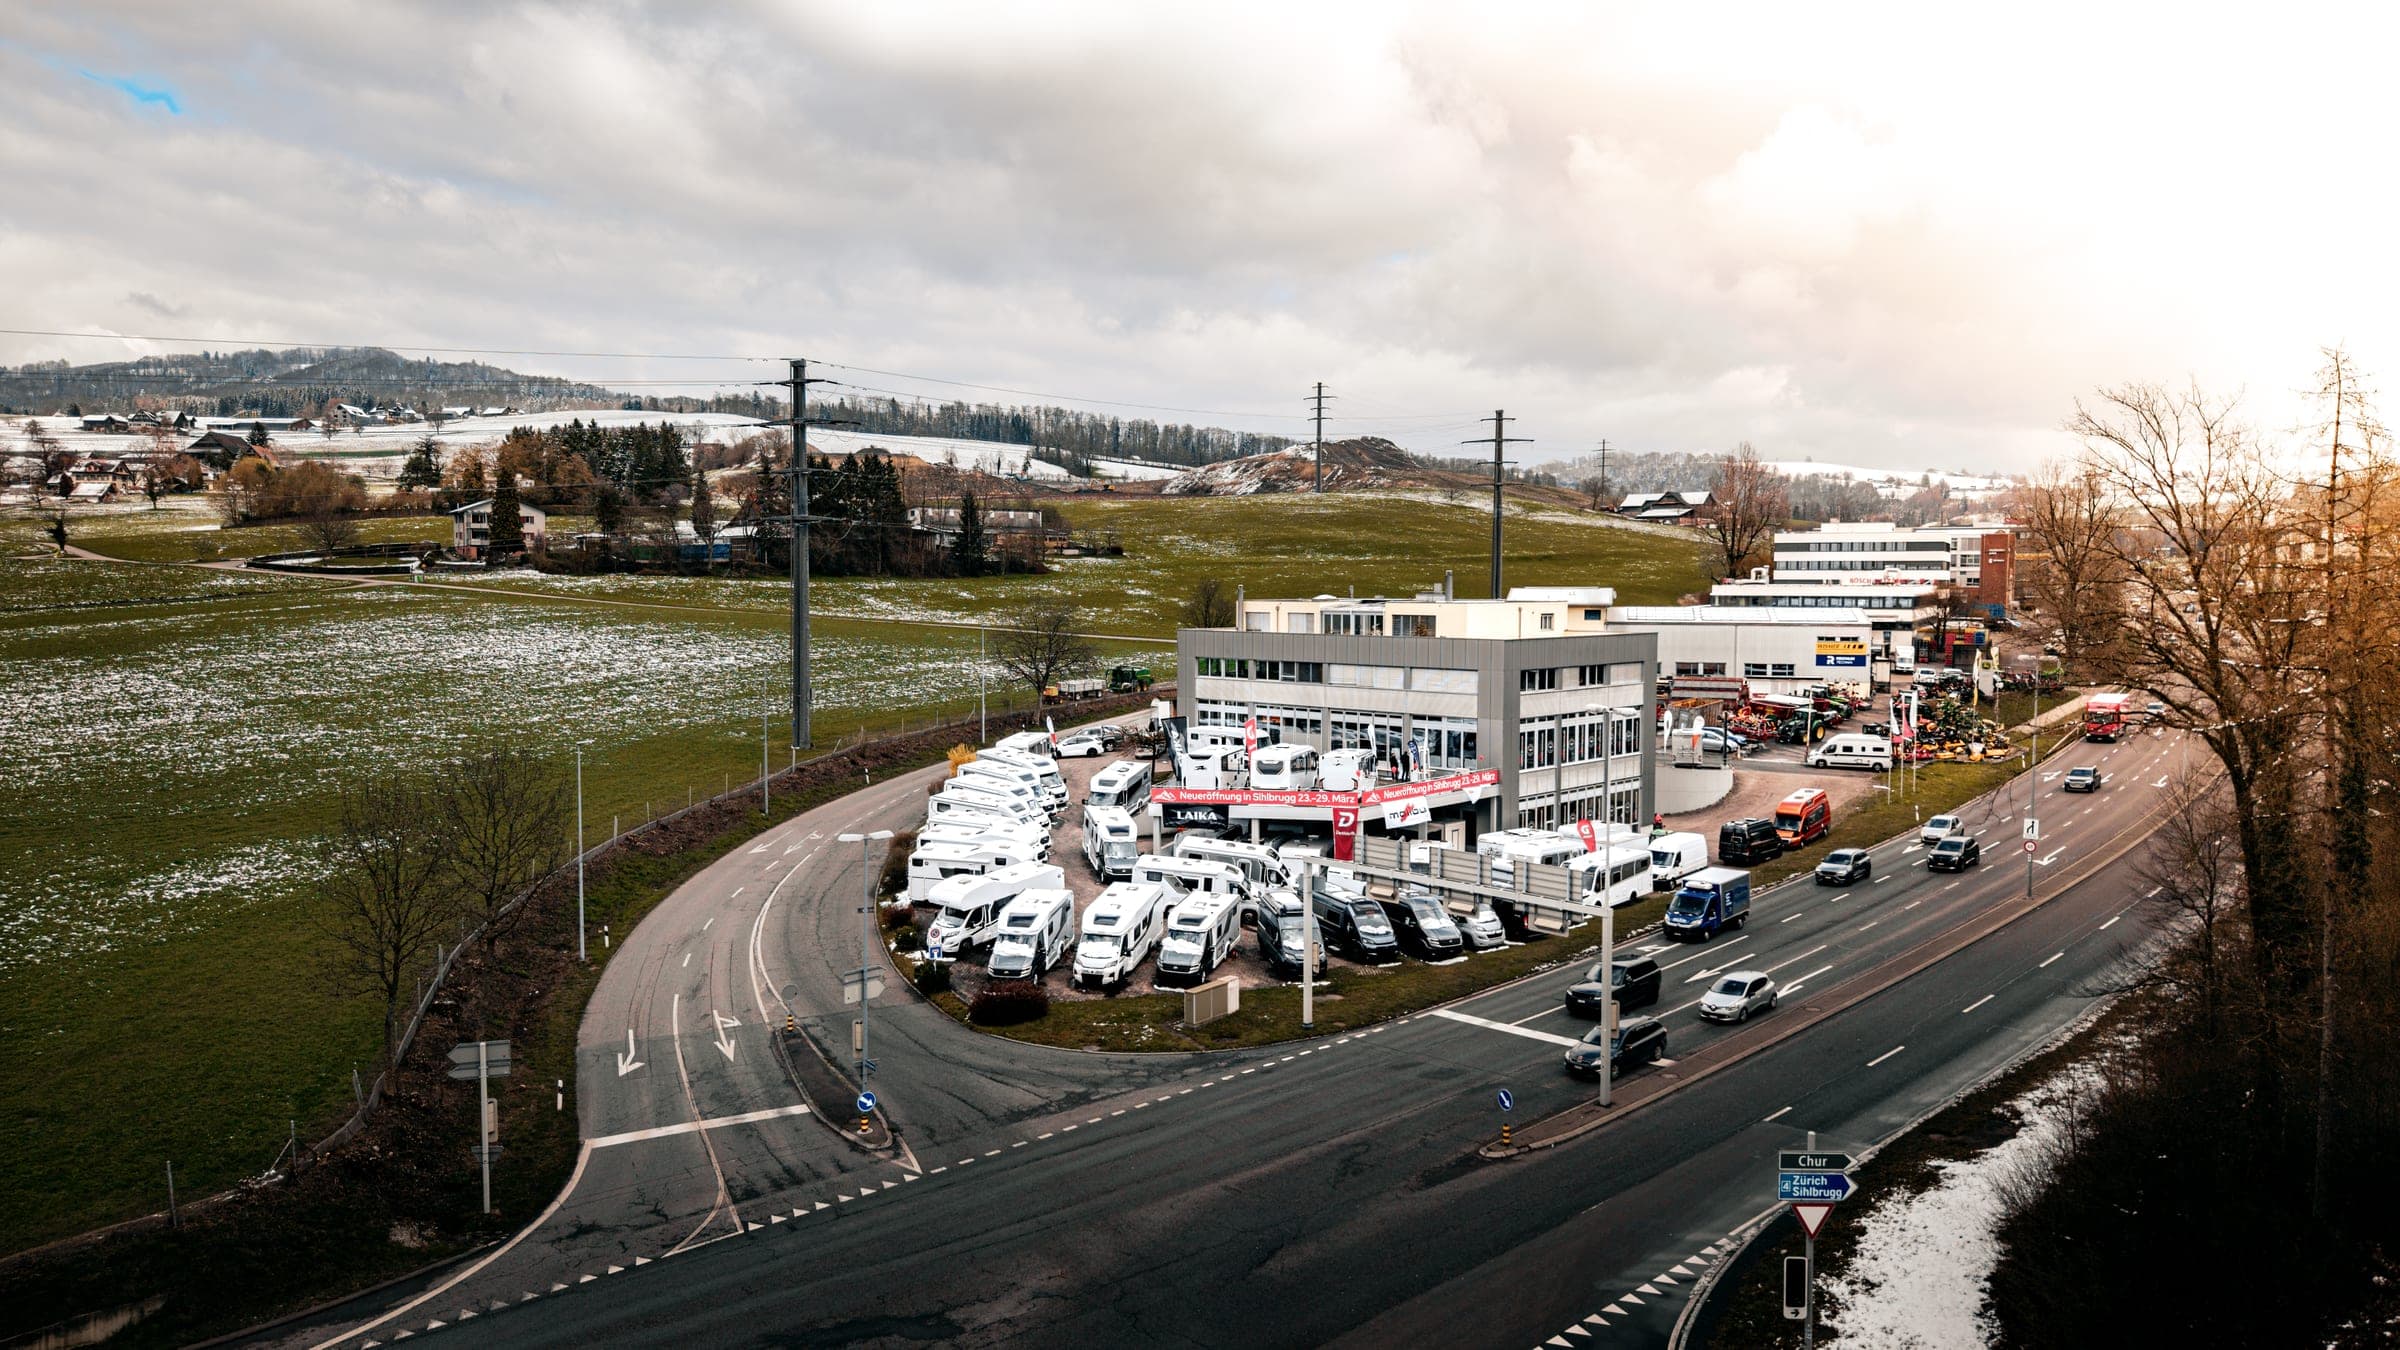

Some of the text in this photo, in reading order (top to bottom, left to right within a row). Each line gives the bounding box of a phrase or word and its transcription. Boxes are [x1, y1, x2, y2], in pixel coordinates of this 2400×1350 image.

[1384, 785, 1427, 798] Neueröffnung
[1433, 779, 1461, 791] Sihlbrugg
[1180, 791, 1355, 803] Neueröffnung in Sihlbrugg 23.-29. März
[1177, 811, 1217, 820] LAIKA
[1798, 1155, 1828, 1167] Chur
[1792, 1175, 1828, 1186] Zürich
[1792, 1187, 1842, 1200] Sihlbrugg
